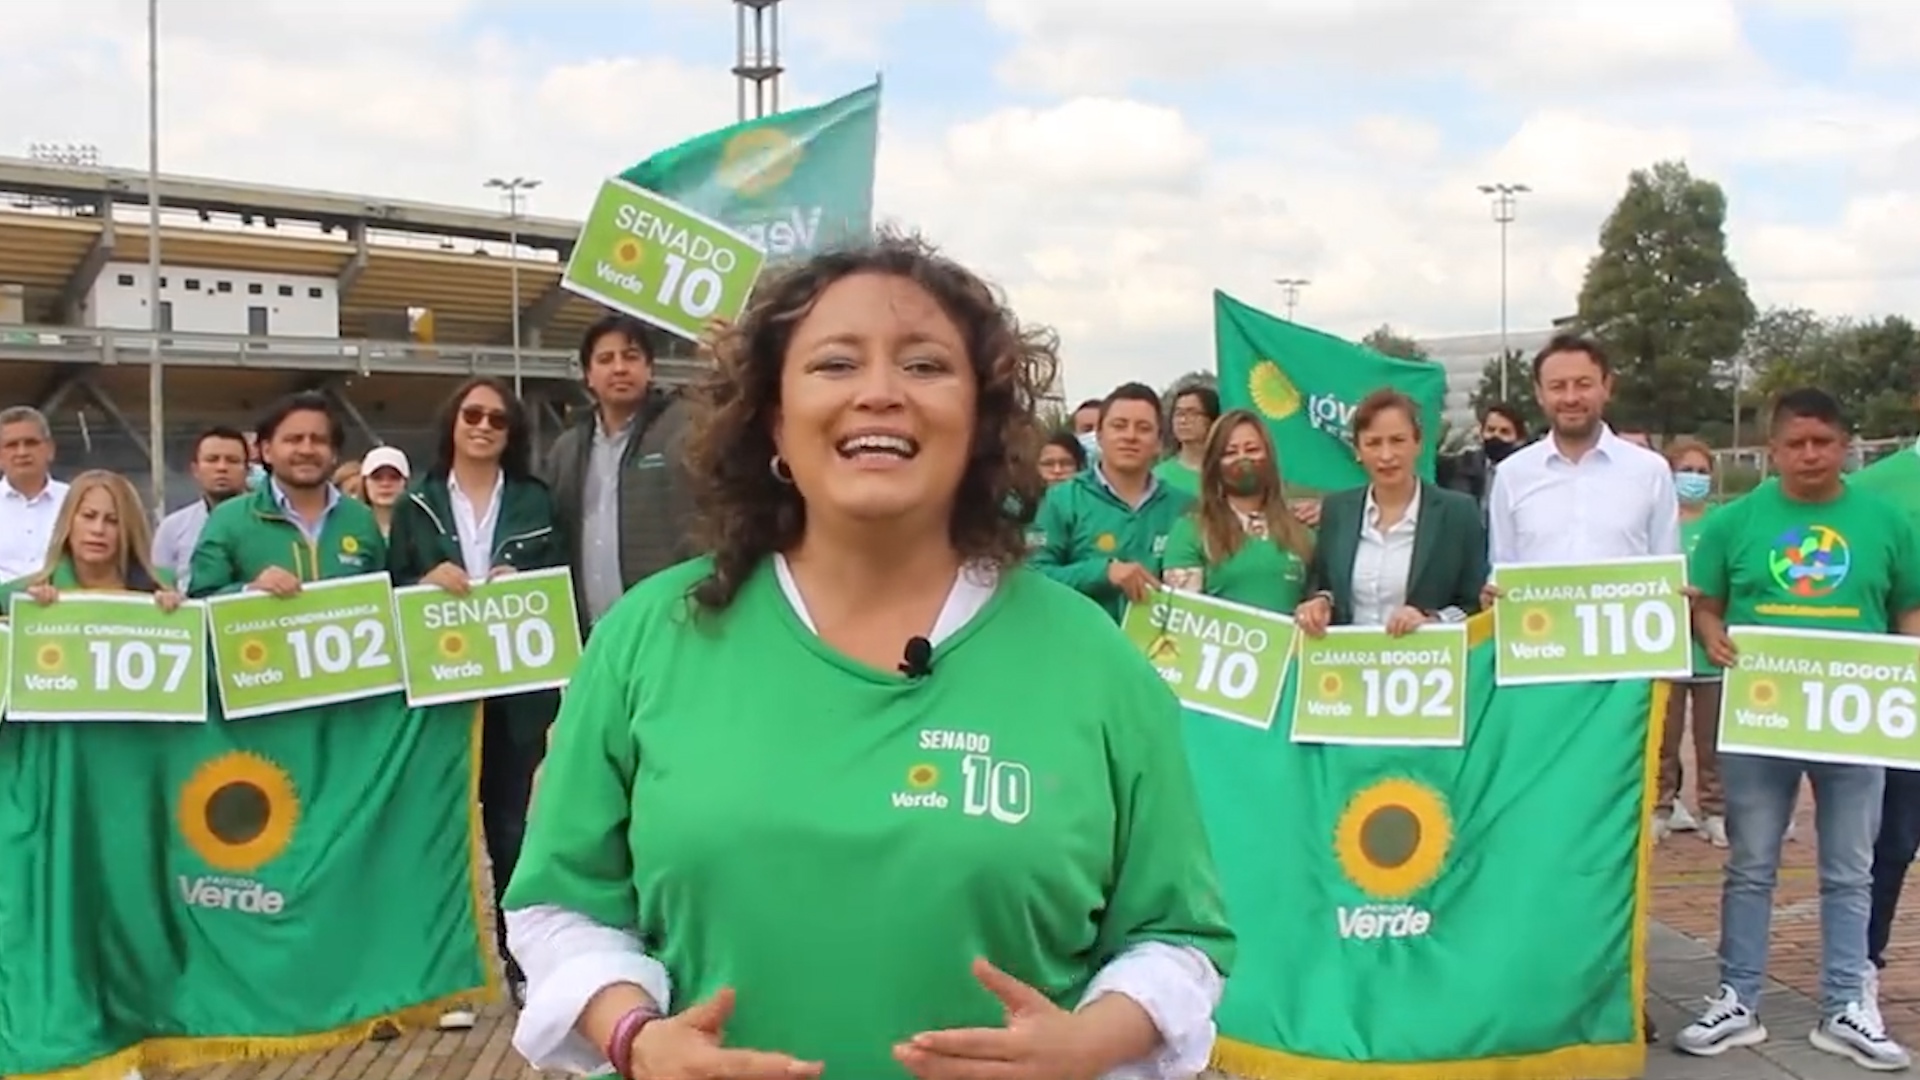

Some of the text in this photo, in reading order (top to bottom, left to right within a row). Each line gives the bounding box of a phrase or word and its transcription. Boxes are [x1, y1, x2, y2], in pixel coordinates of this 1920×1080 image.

[615, 204, 736, 273] SENADO
[596, 260, 644, 295] Verde
[656, 253, 722, 318] 10
[1591, 576, 1672, 599] BOGOTÁ
[423, 590, 549, 628] SENADO
[488, 617, 555, 673] 10
[1149, 603, 1268, 653] SENADO
[1575, 600, 1676, 656] 110
[89, 640, 192, 693] 107
[286, 618, 391, 679] 102
[1381, 646, 1451, 665] BOGOTÁ
[1510, 642, 1566, 659] Verde
[24, 674, 78, 691] Verde
[232, 668, 283, 688] Verde
[431, 661, 483, 681] Verde
[1195, 643, 1259, 699] 10
[1829, 661, 1917, 683] BOGOTÁ
[1307, 700, 1352, 716] Verde
[1362, 668, 1454, 717] 102
[1802, 681, 1917, 739] 106
[1735, 709, 1789, 729] Verde
[919, 729, 990, 753] SENADO
[892, 791, 949, 808] Verde
[962, 754, 1030, 824] 10
[179, 875, 284, 914] Verde
[1337, 905, 1431, 939] Verde
